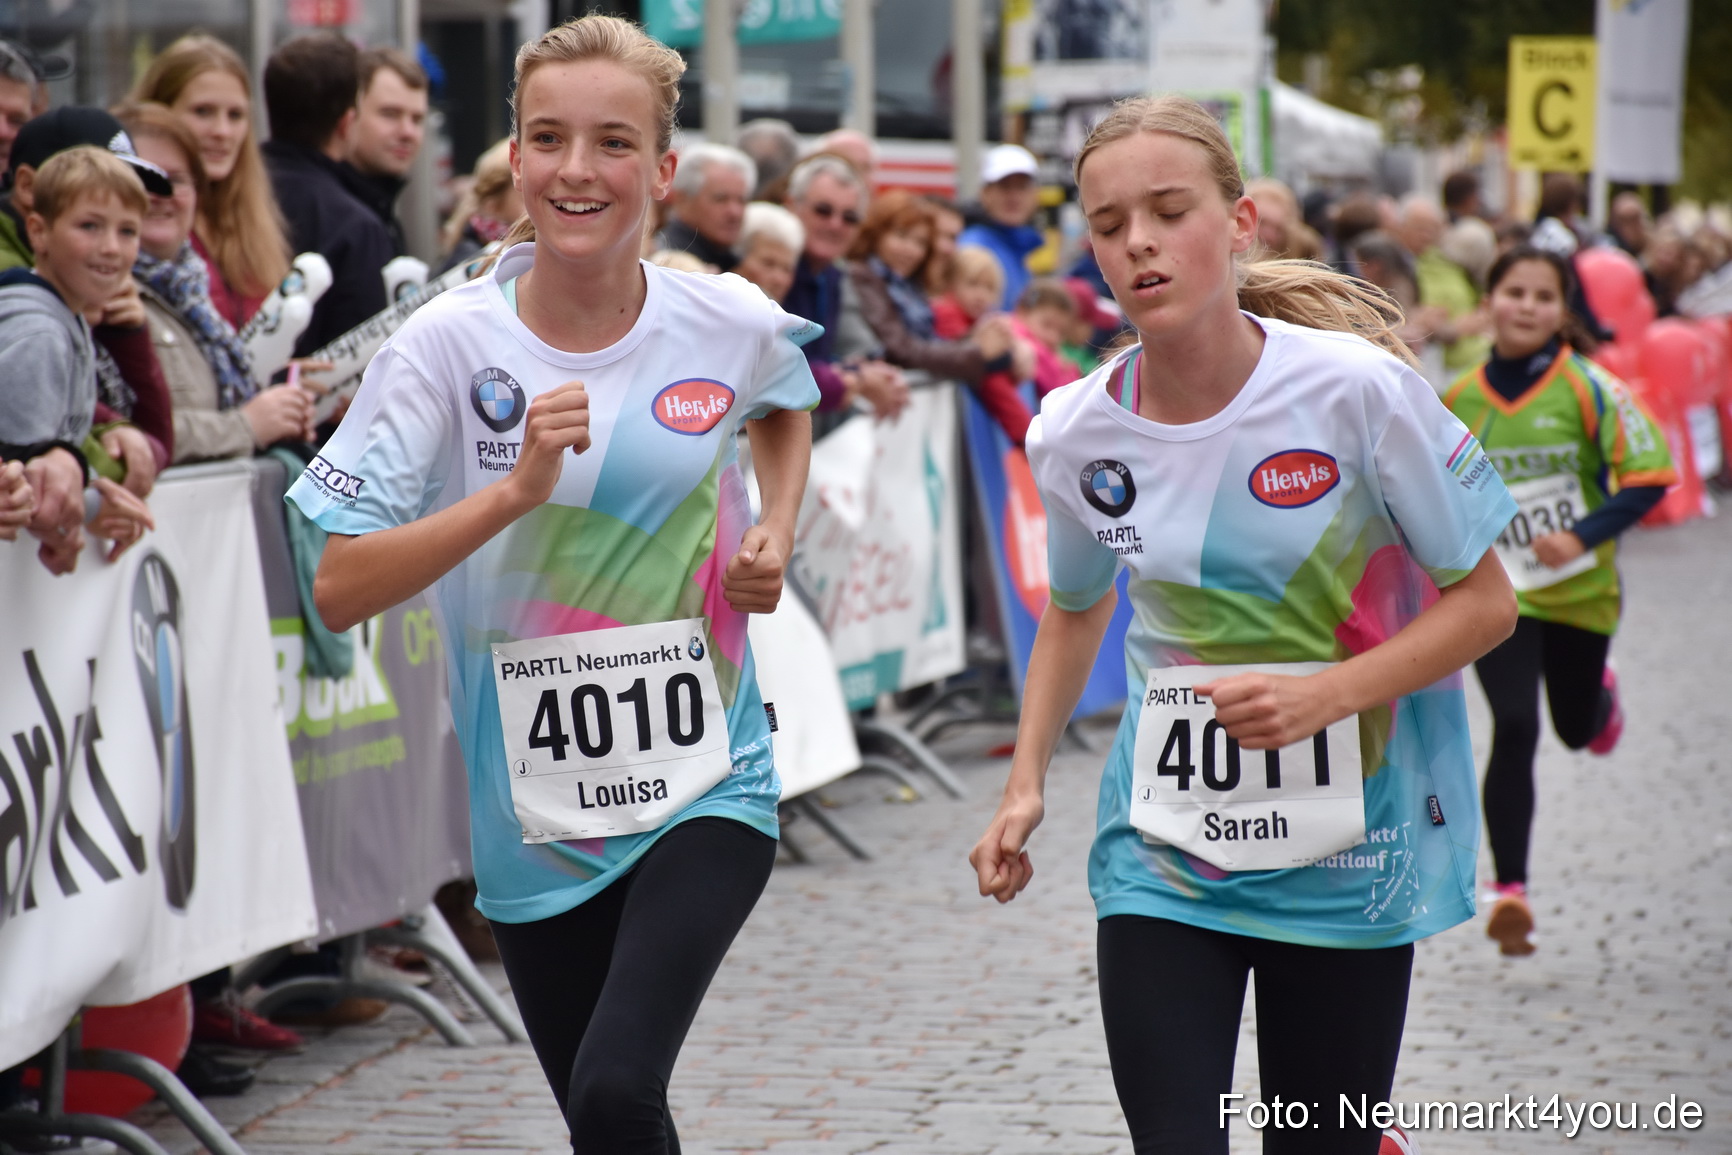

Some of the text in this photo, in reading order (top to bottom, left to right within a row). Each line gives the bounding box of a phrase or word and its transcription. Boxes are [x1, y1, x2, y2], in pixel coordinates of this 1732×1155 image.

[1532, 78, 1574, 141] C
[663, 394, 728, 420] Hervis
[672, 416, 703, 425] SPORTS
[476, 440, 523, 459] PART
[478, 458, 516, 472] Neuma
[1261, 463, 1331, 492] Hervis
[1269, 488, 1303, 500] SPORTS
[1097, 525, 1142, 545] PARTL
[1111, 542, 1144, 556] markt
[501, 644, 682, 680] PARTL Neumarkt
[528, 672, 705, 761] 4010
[1157, 717, 1330, 791] 4011
[519, 761, 526, 775] J
[577, 776, 668, 810] Louisa
[1143, 788, 1151, 801] J
[1204, 811, 1288, 841] Sarah
[1378, 869, 1407, 912] September
